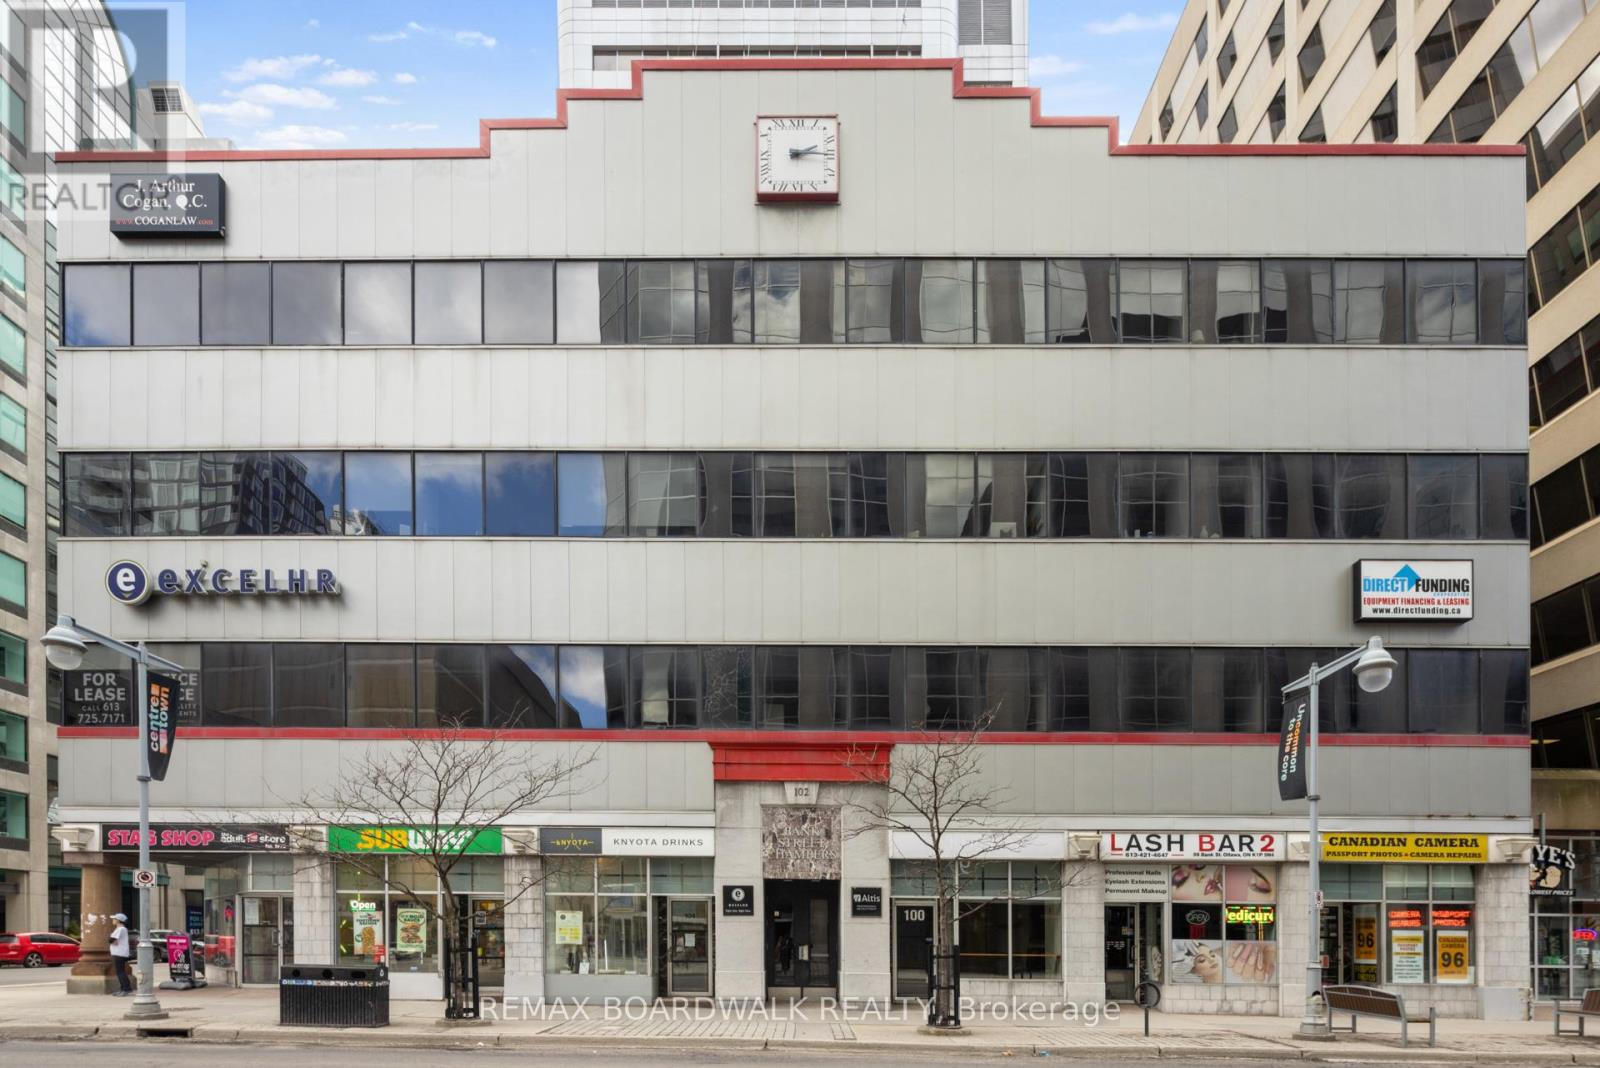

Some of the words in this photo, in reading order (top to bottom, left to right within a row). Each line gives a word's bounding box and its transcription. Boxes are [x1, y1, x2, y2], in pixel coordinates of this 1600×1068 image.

[135, 180, 146, 192] J.
[150, 180, 195, 192] Arthur
[123, 194, 171, 211] Cogan,
[176, 194, 208, 210] Q.C.
[1363, 578, 1405, 593] DIRECT
[1415, 578, 1470, 593] FUNDING
[1372, 607, 1461, 615] www.directfunding.ca
[83, 673, 117, 687] FOR
[74, 688, 126, 701] LEASE
[102, 702, 120, 711] 613
[159, 687, 170, 728] town
[78, 714, 125, 723] 725.7171
[150, 696, 160, 752] centre
[1288, 718, 1296, 731] to
[1284, 734, 1293, 752] the
[1290, 703, 1306, 772] Uncommon
[1281, 755, 1289, 781] core
[794, 788, 809, 797] 102
[161, 830, 214, 846] SHOP
[259, 834, 286, 843] store
[357, 829, 473, 849] SUBWAY
[1110, 832, 1184, 852] LASH
[1328, 836, 1407, 847] CANADIAN
[1415, 837, 1479, 848] CAMERA
[351, 900, 376, 911] Open
[904, 909, 925, 921] 100
[1226, 909, 1273, 921] edicur
[1358, 932, 1374, 948] 96
[1441, 951, 1464, 968] 96
